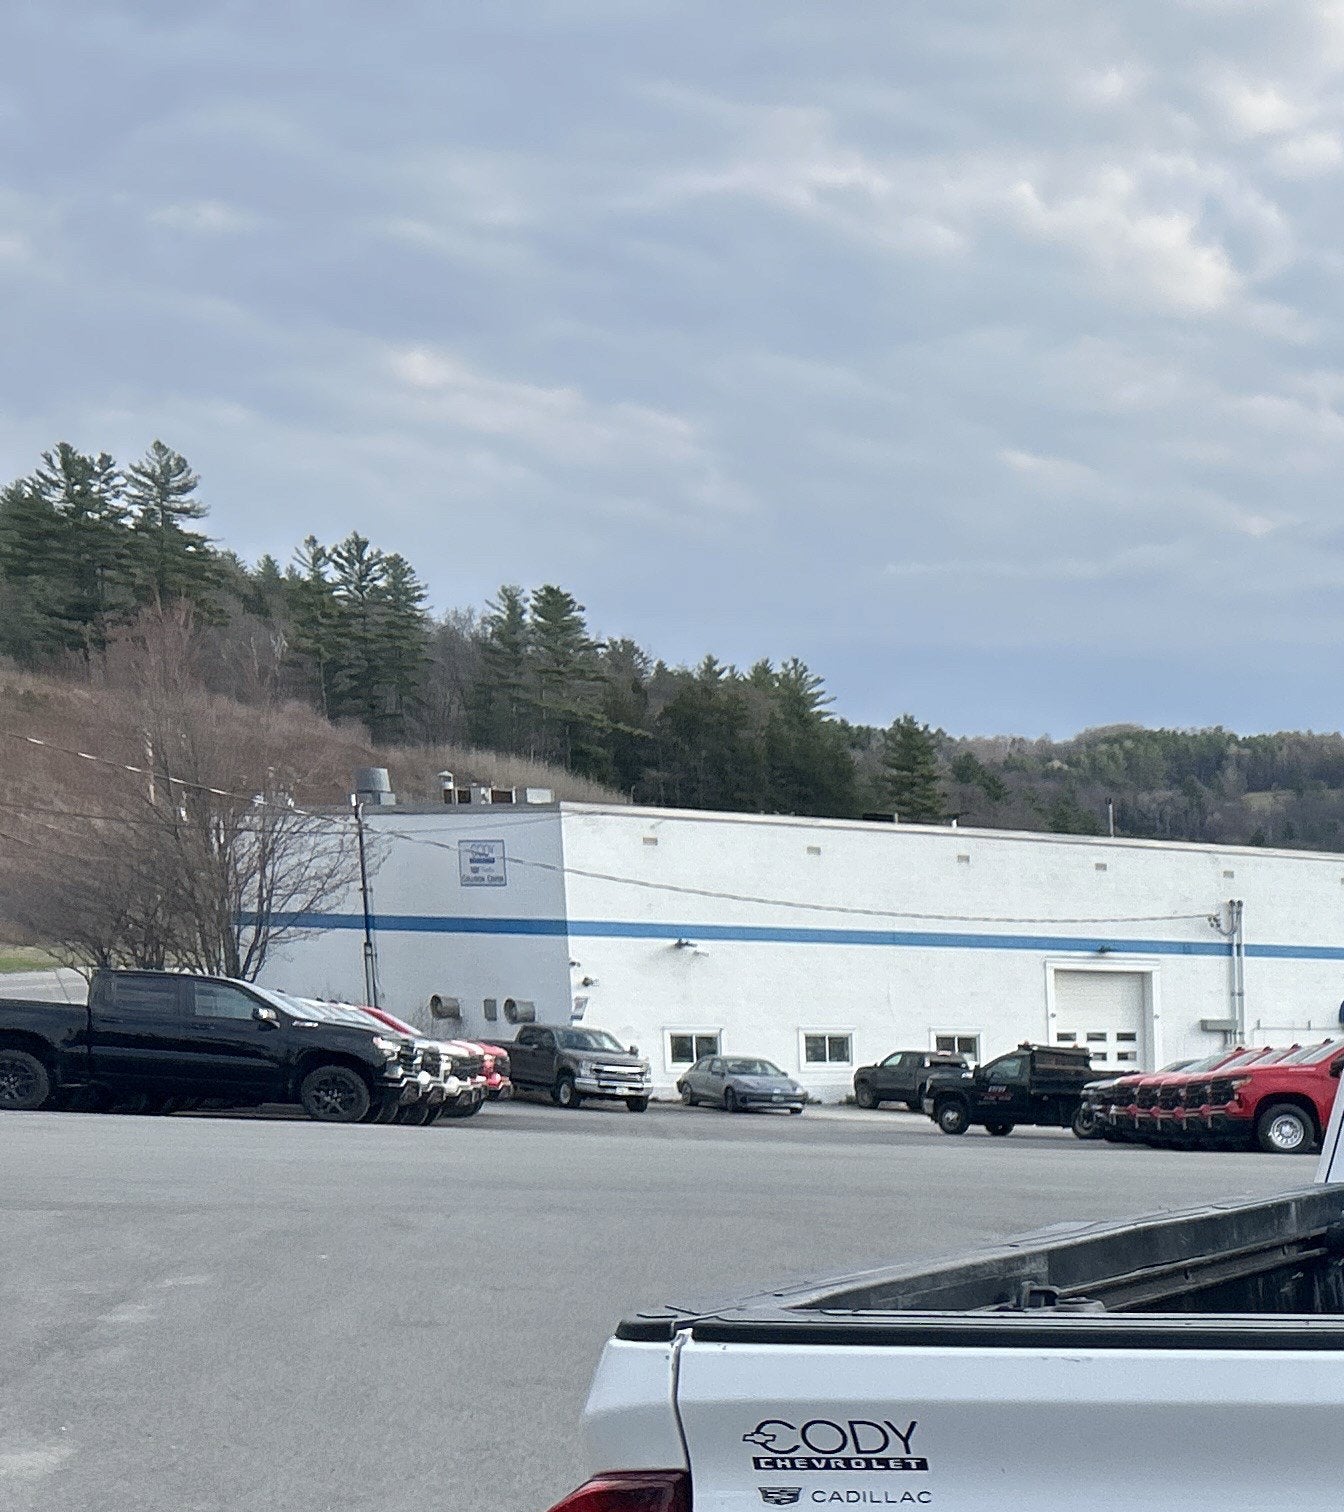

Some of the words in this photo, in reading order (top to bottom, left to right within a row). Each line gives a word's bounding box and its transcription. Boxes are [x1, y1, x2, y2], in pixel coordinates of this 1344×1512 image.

[743, 1419, 917, 1454] CODY
[758, 1458, 922, 1469] CHEVROLET
[811, 1490, 932, 1504] CADILLAC
